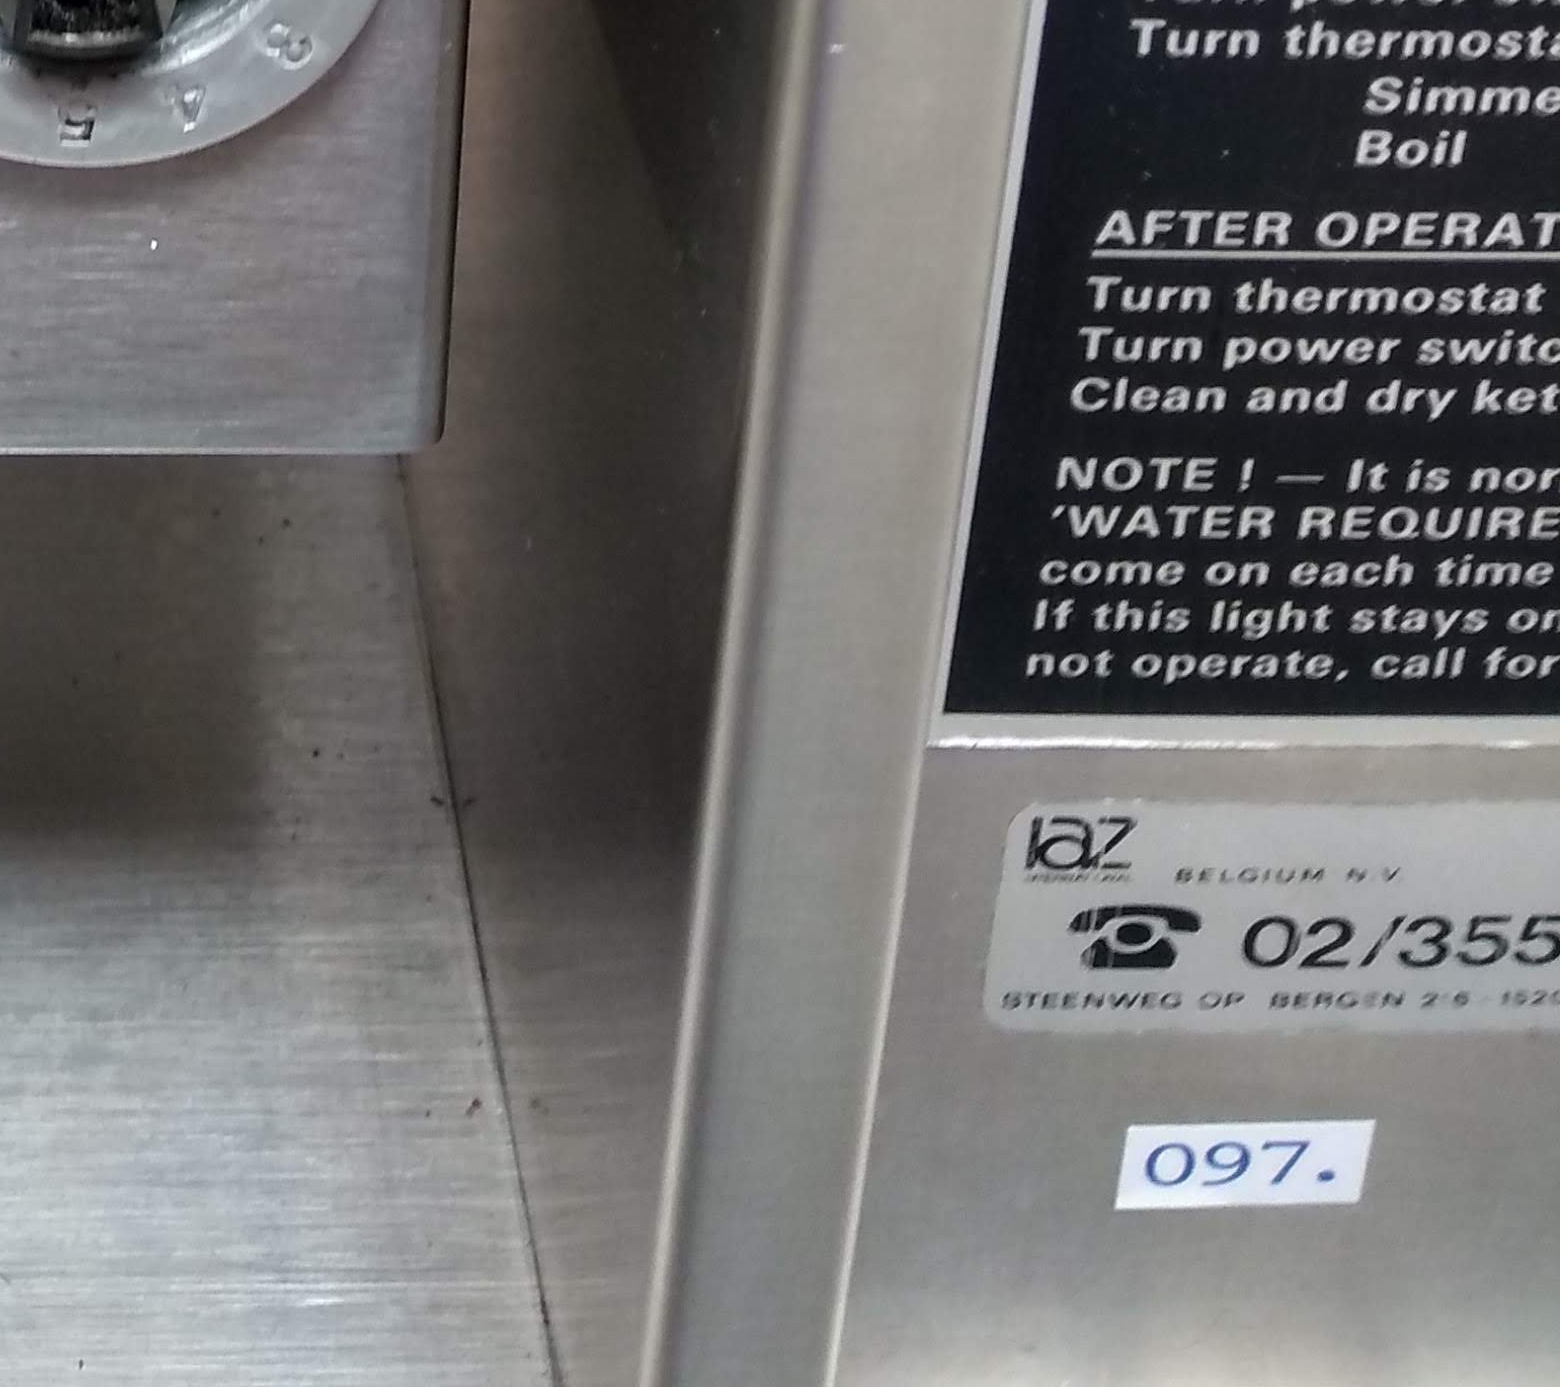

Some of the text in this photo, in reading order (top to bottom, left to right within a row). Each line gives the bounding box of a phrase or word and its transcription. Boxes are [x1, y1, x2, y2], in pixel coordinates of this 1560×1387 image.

[264, 23, 314, 69] 3
[1130, 17, 1262, 59] Turn
[172, 83, 207, 132] 4
[1362, 76, 1560, 117] Simme
[57, 99, 98, 147] 5
[1353, 128, 1468, 169] Boil
[1094, 209, 1294, 249] AFTER
[1086, 275, 1547, 317] Turn thermostat
[1078, 326, 1560, 372] Turn power switc
[1069, 376, 1228, 415] Clean
[1245, 380, 1350, 415] and
[1364, 380, 1458, 422] dry
[1055, 456, 1219, 492] NOTE
[1346, 458, 1391, 494] It
[1405, 459, 1452, 494] is
[1296, 507, 1560, 542] REQUIRE
[1040, 555, 1555, 589] come on each time
[1033, 599, 1075, 632] If
[1091, 600, 1192, 633] this
[1209, 601, 1334, 639] light
[1349, 604, 1490, 639] stays
[1025, 647, 1560, 685] not operate, call for
[1175, 867, 1324, 884] BELGIUM
[1242, 914, 1560, 970] 02/355
[1001, 991, 1183, 1010] STEENWEG
[1198, 991, 1245, 1009] OP
[1269, 991, 1405, 1010] BERGEN
[1144, 1140, 1336, 1186] 097.
